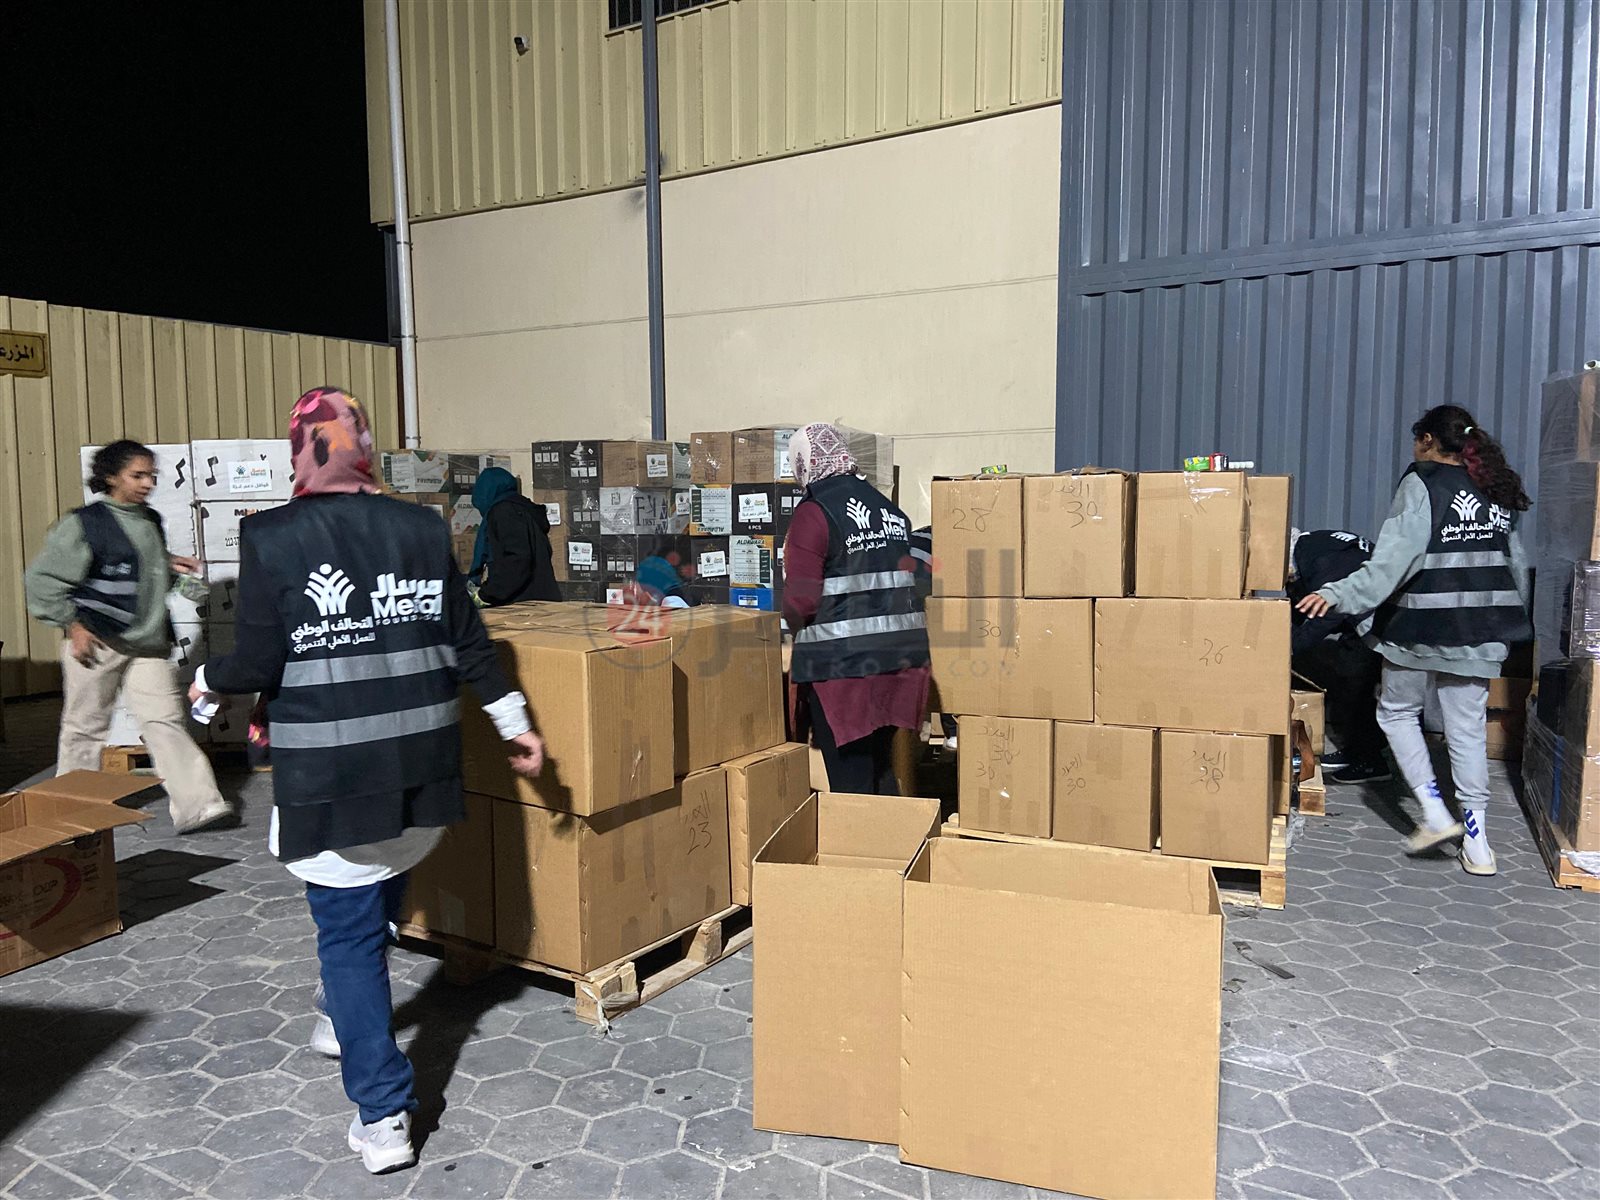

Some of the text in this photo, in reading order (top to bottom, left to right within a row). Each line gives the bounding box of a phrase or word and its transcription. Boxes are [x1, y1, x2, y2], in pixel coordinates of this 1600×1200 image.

[0, 344, 34, 362] المزرع
[1066, 501, 1098, 528] 30
[370, 573, 443, 599] مرسال
[291, 615, 374, 643] التحالف الوطني
[975, 619, 1002, 639] 30
[1066, 777, 1087, 796] 30
[687, 821, 713, 855] 23
